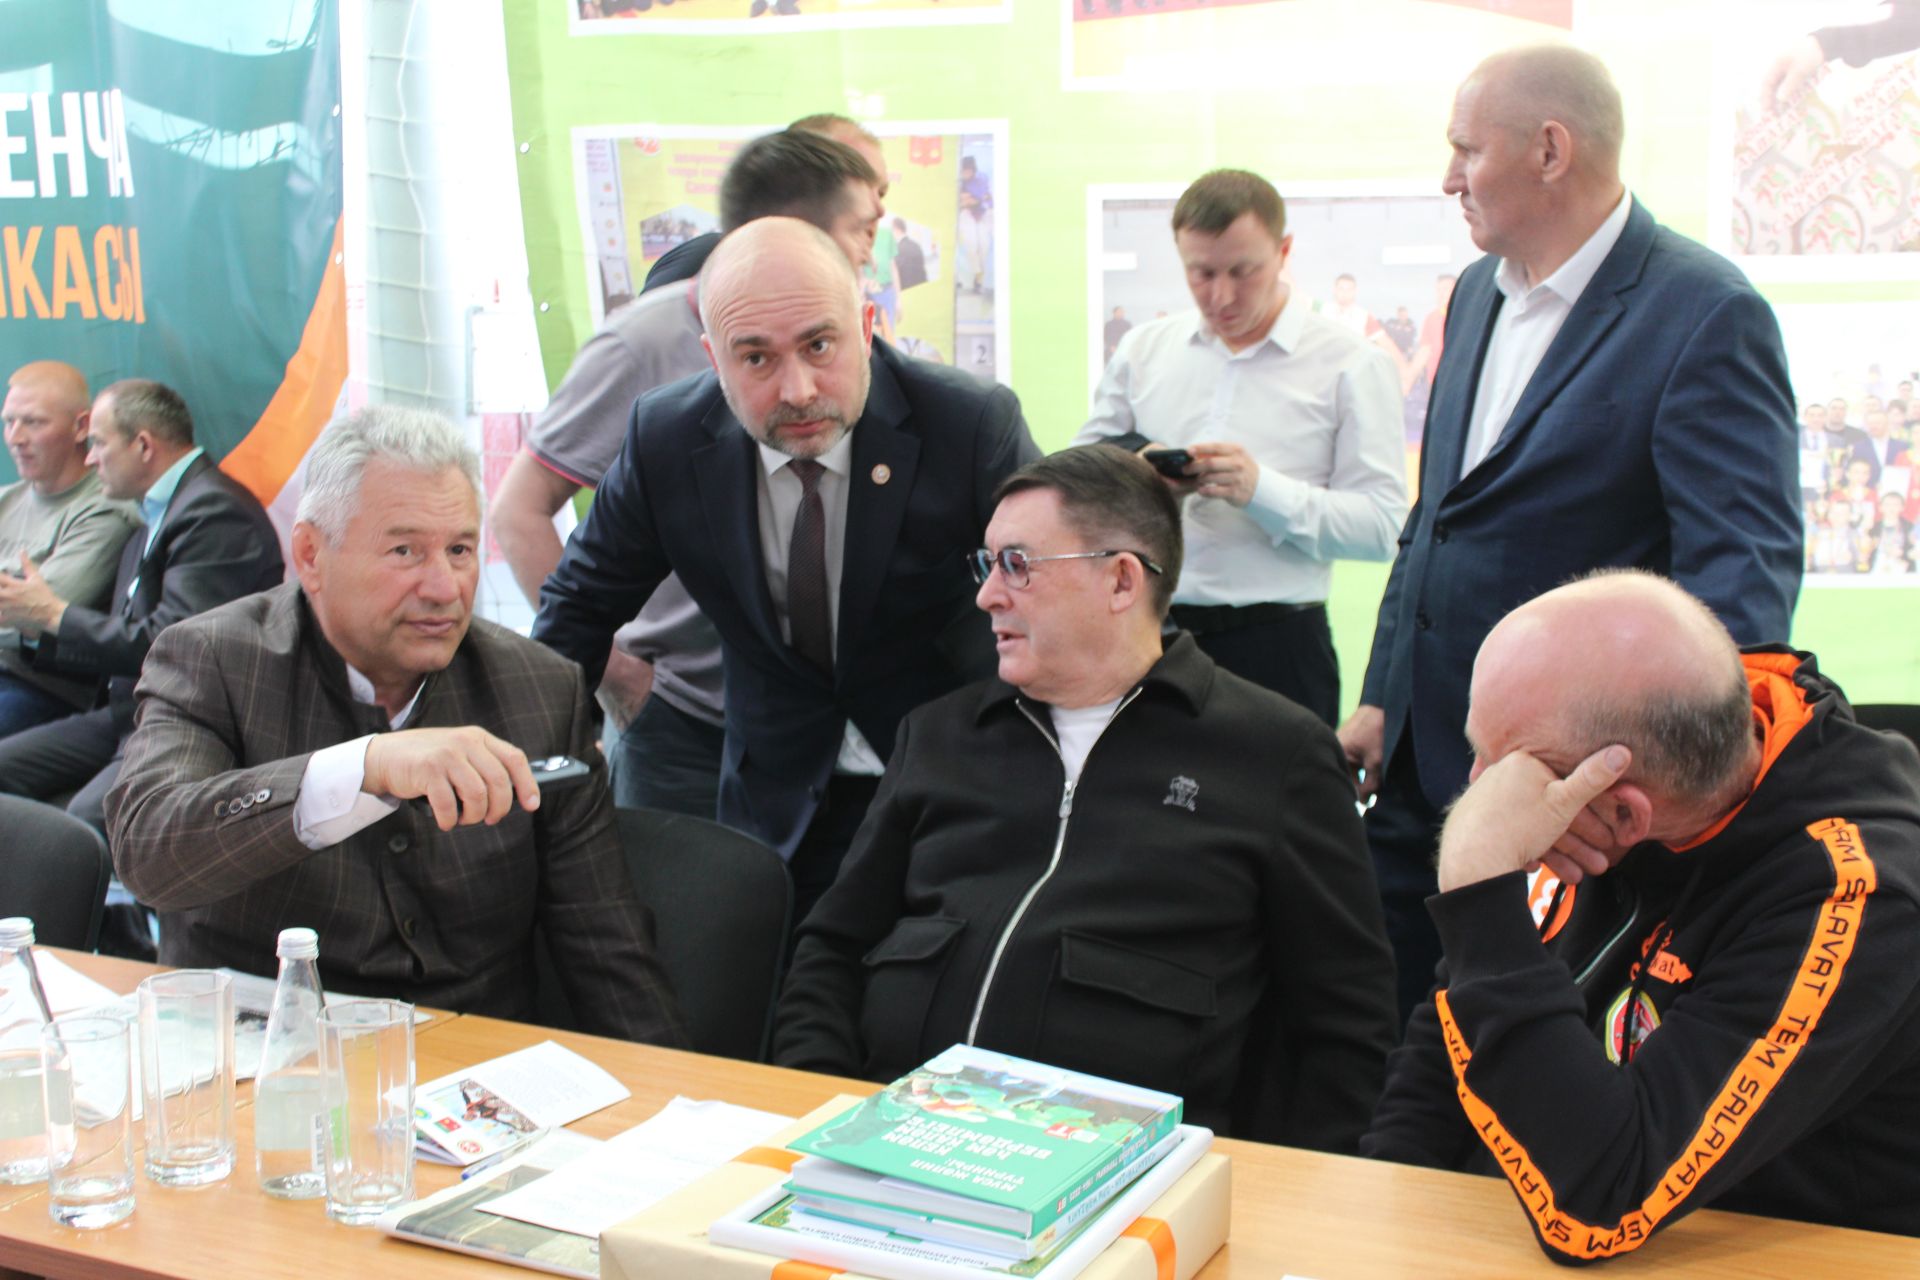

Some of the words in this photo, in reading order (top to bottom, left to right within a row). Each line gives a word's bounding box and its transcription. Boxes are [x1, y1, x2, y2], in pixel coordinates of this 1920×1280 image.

[0, 224, 146, 324] КАСЫ
[971, 1174, 1017, 1192] МУСА
[1478, 1120, 1574, 1244] SALAVAT
[1664, 1074, 1760, 1202] SALAVAT
